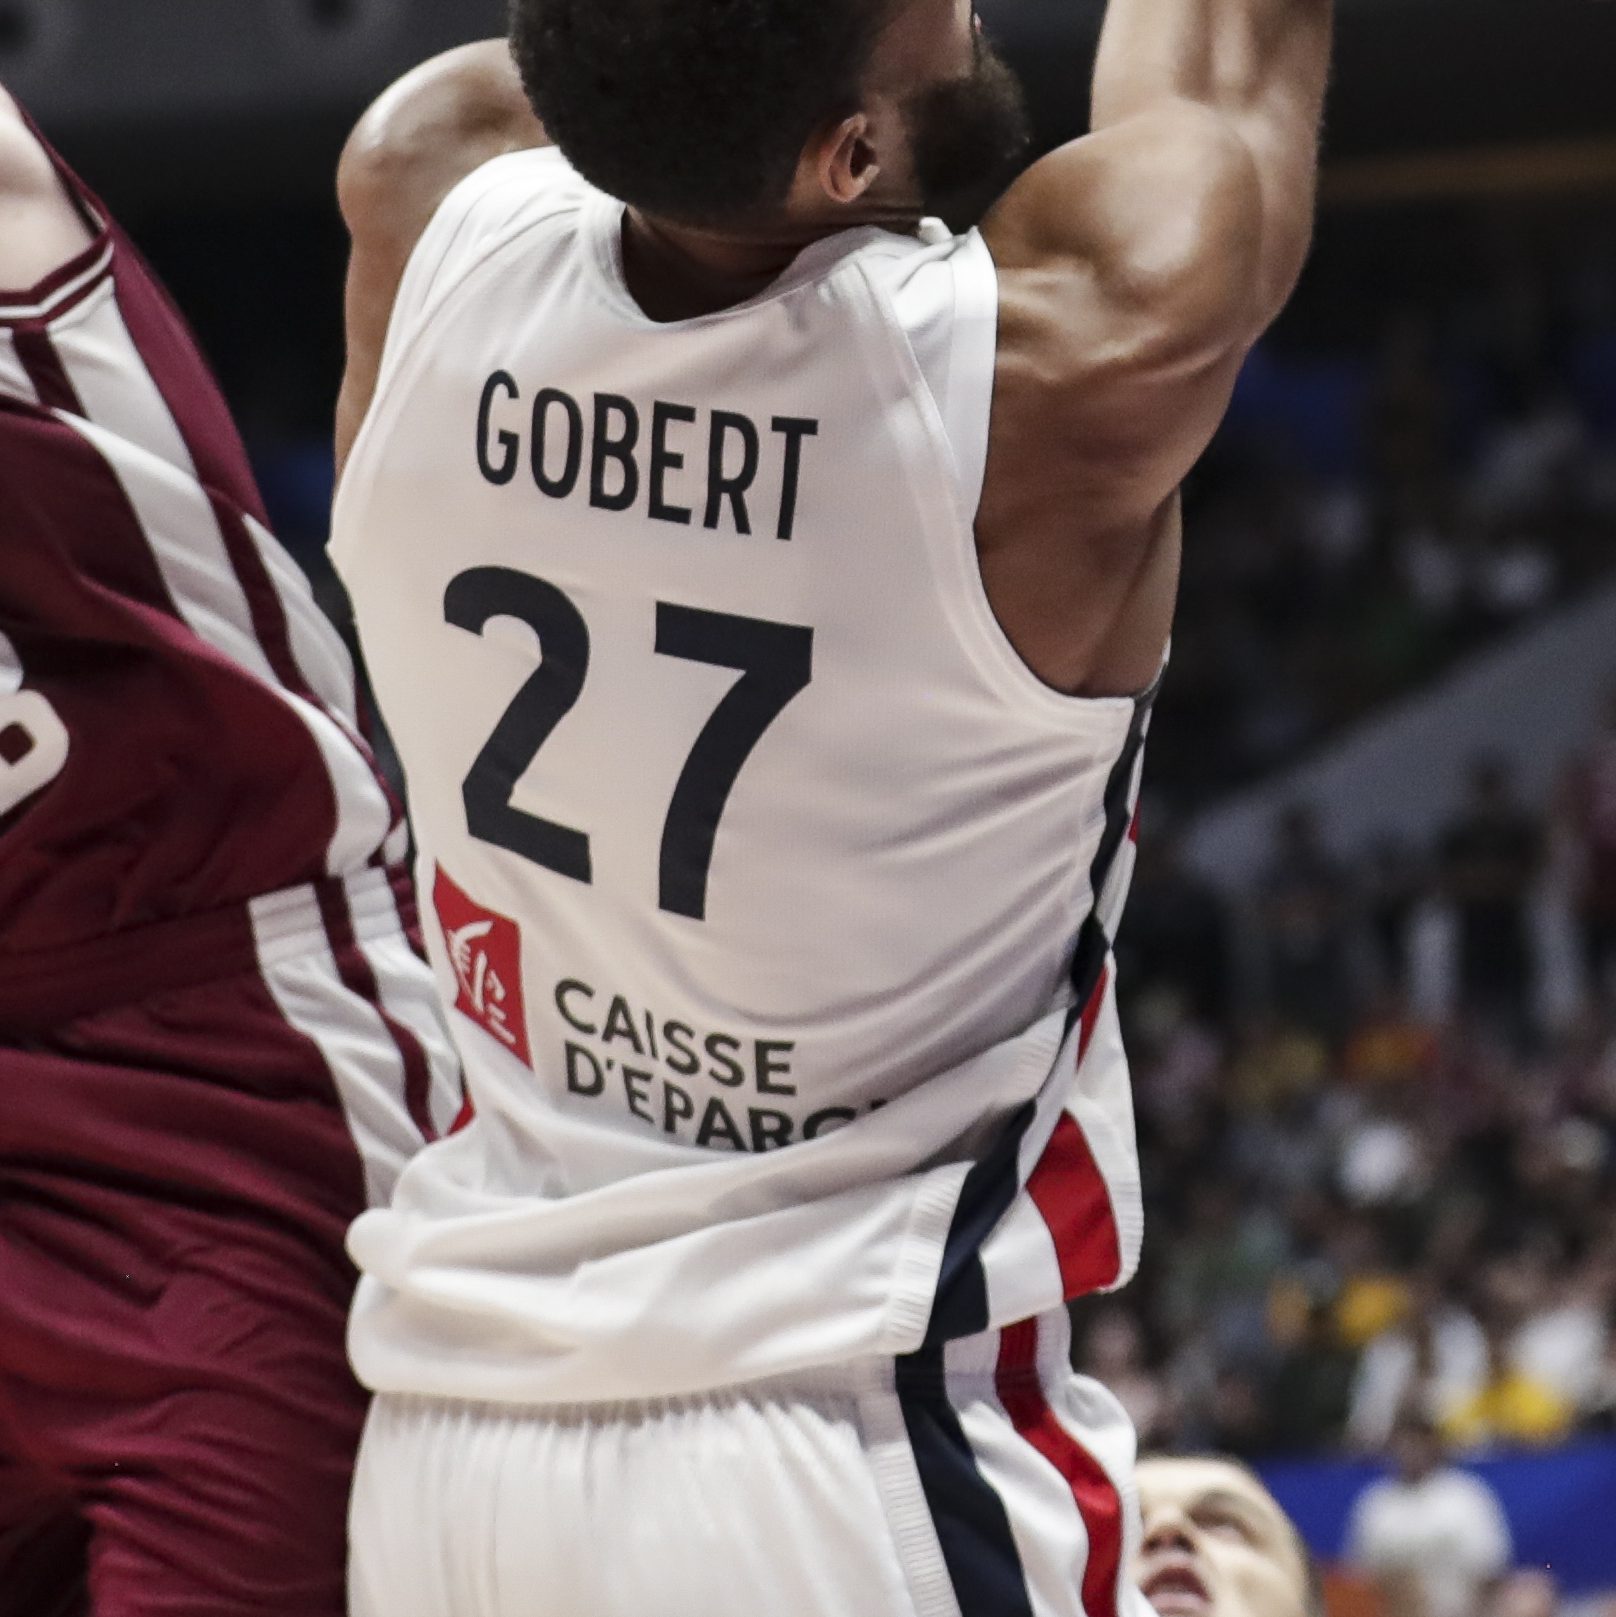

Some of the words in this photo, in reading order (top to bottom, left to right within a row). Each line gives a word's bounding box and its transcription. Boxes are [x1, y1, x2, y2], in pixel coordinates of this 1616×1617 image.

[474, 369, 820, 541] GOBERT
[442, 564, 815, 922] 27
[553, 977, 797, 1097] CAISSE
